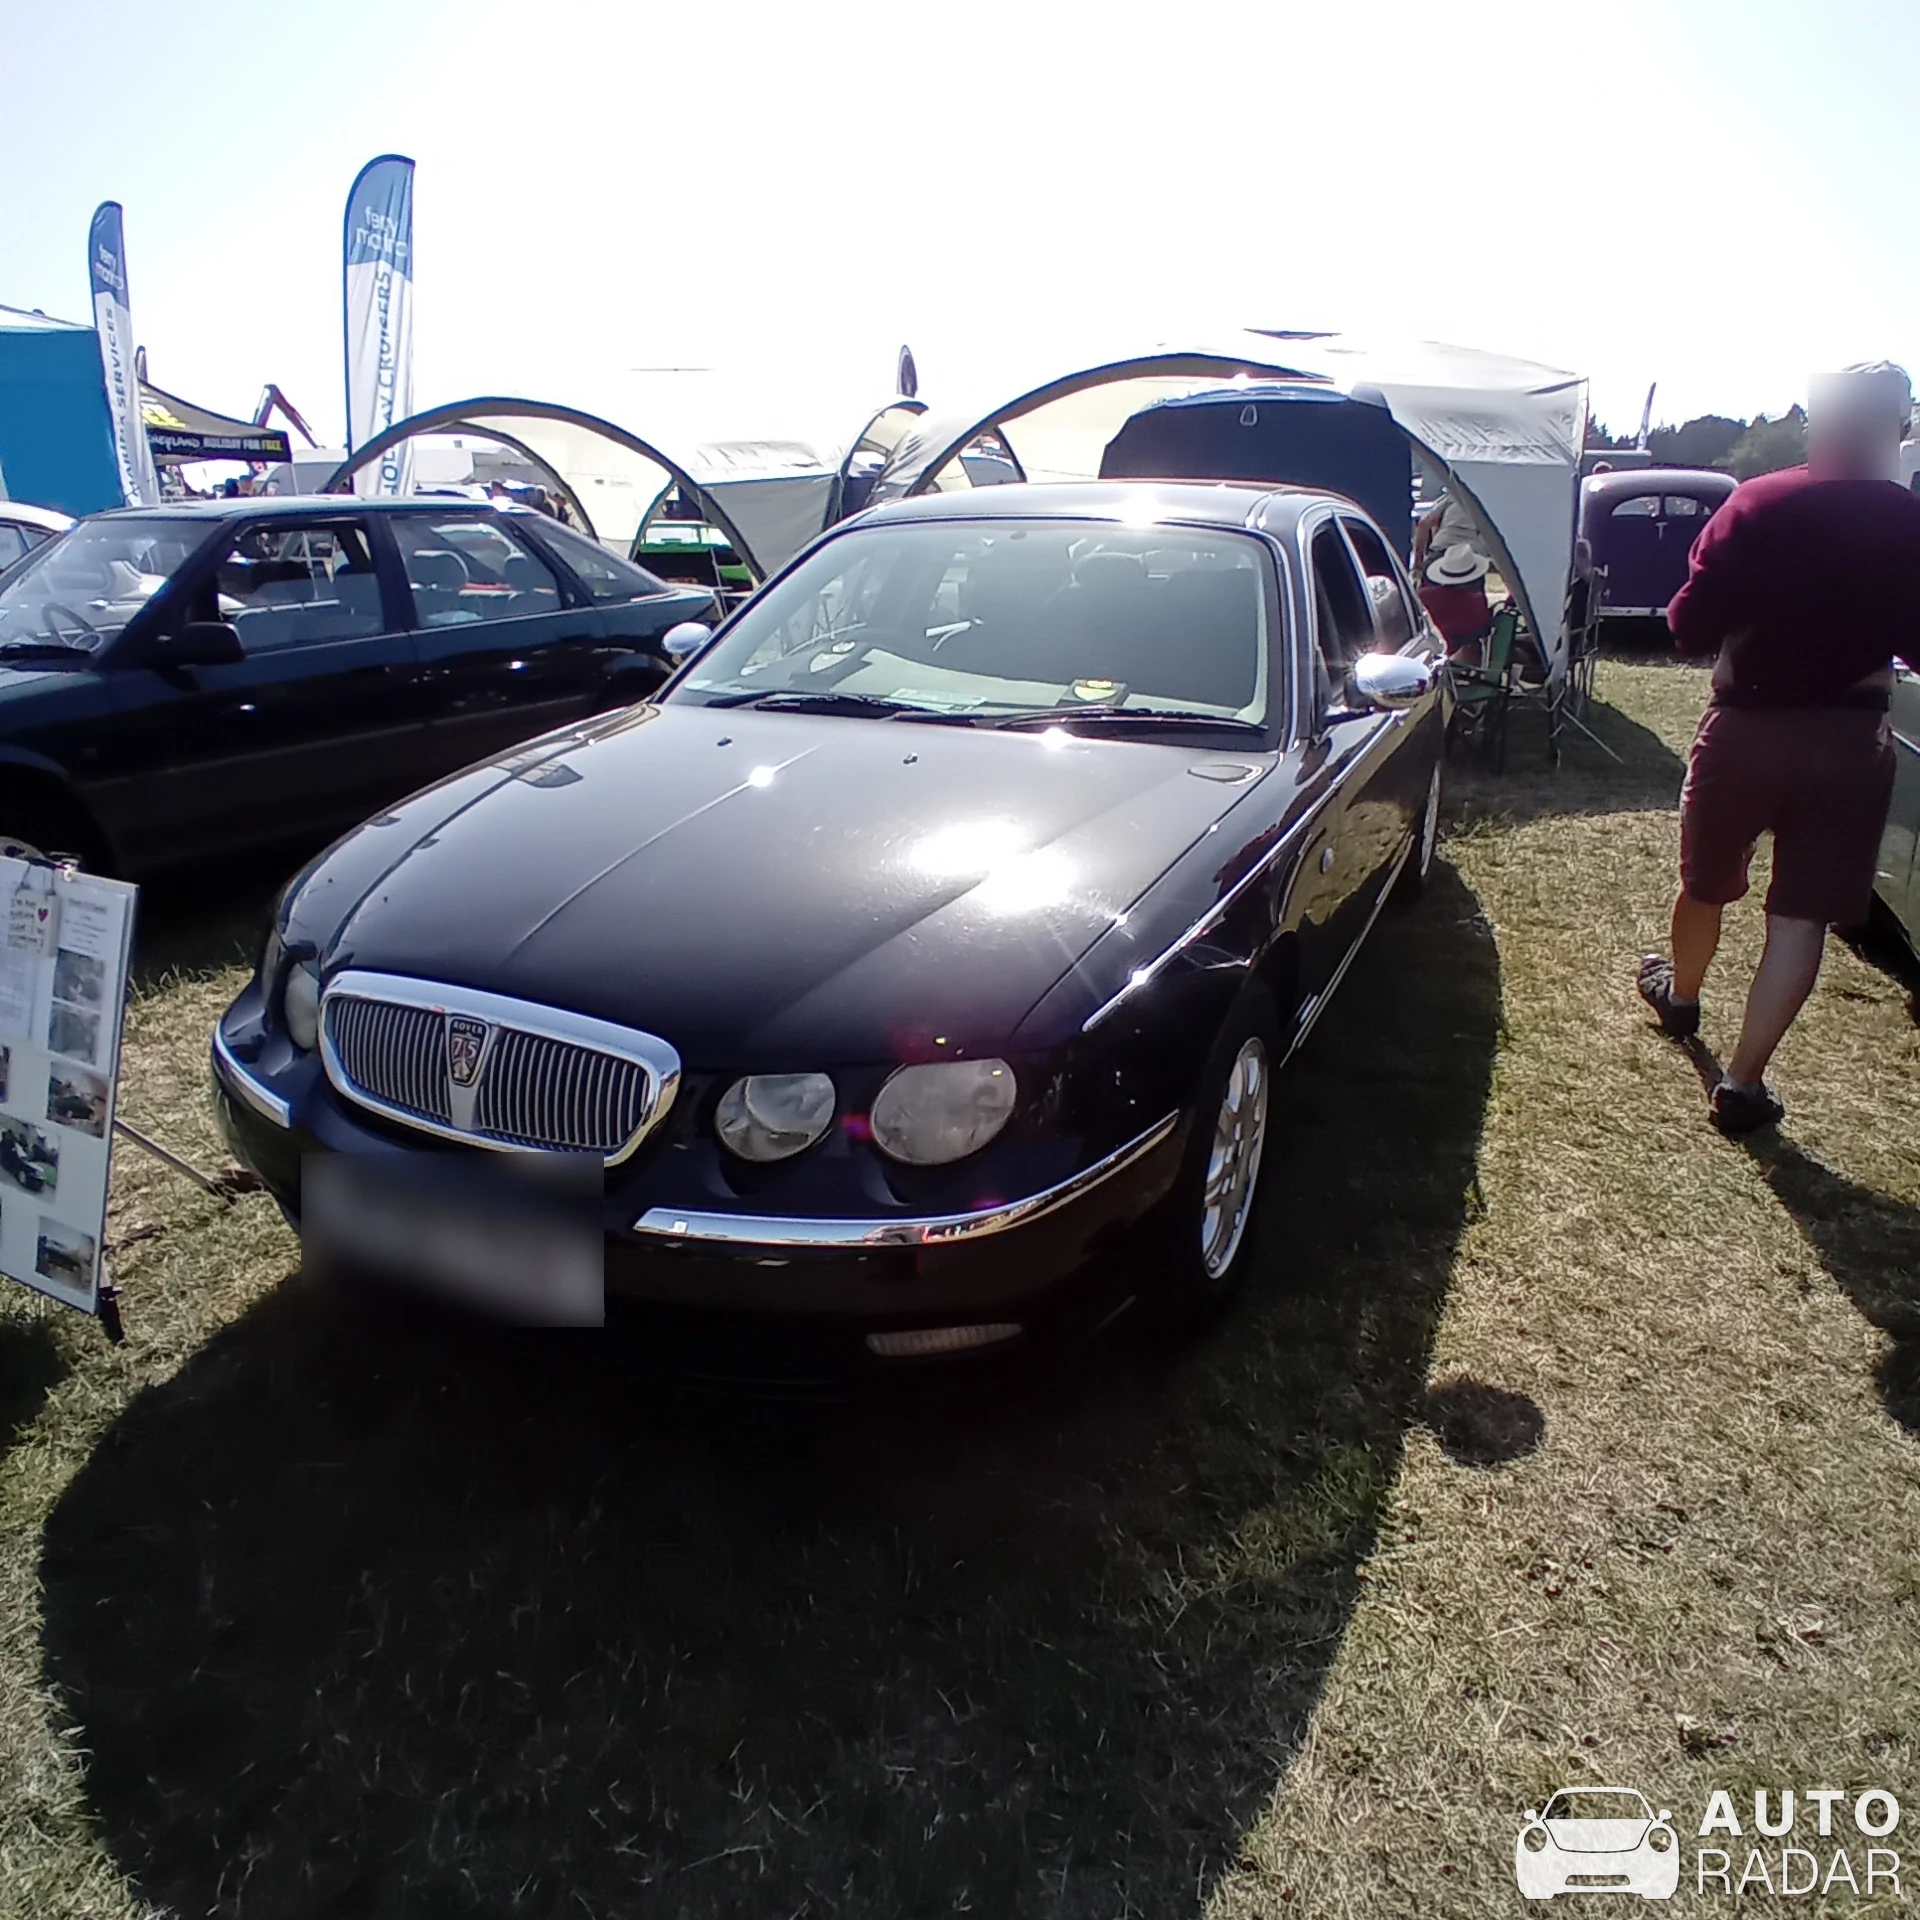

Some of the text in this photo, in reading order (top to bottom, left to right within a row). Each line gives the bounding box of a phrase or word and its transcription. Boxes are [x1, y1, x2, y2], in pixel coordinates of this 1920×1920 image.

[105, 307, 127, 408] SERVICES
[453, 1020, 483, 1035] ROVER
[453, 1037, 478, 1059] 75
